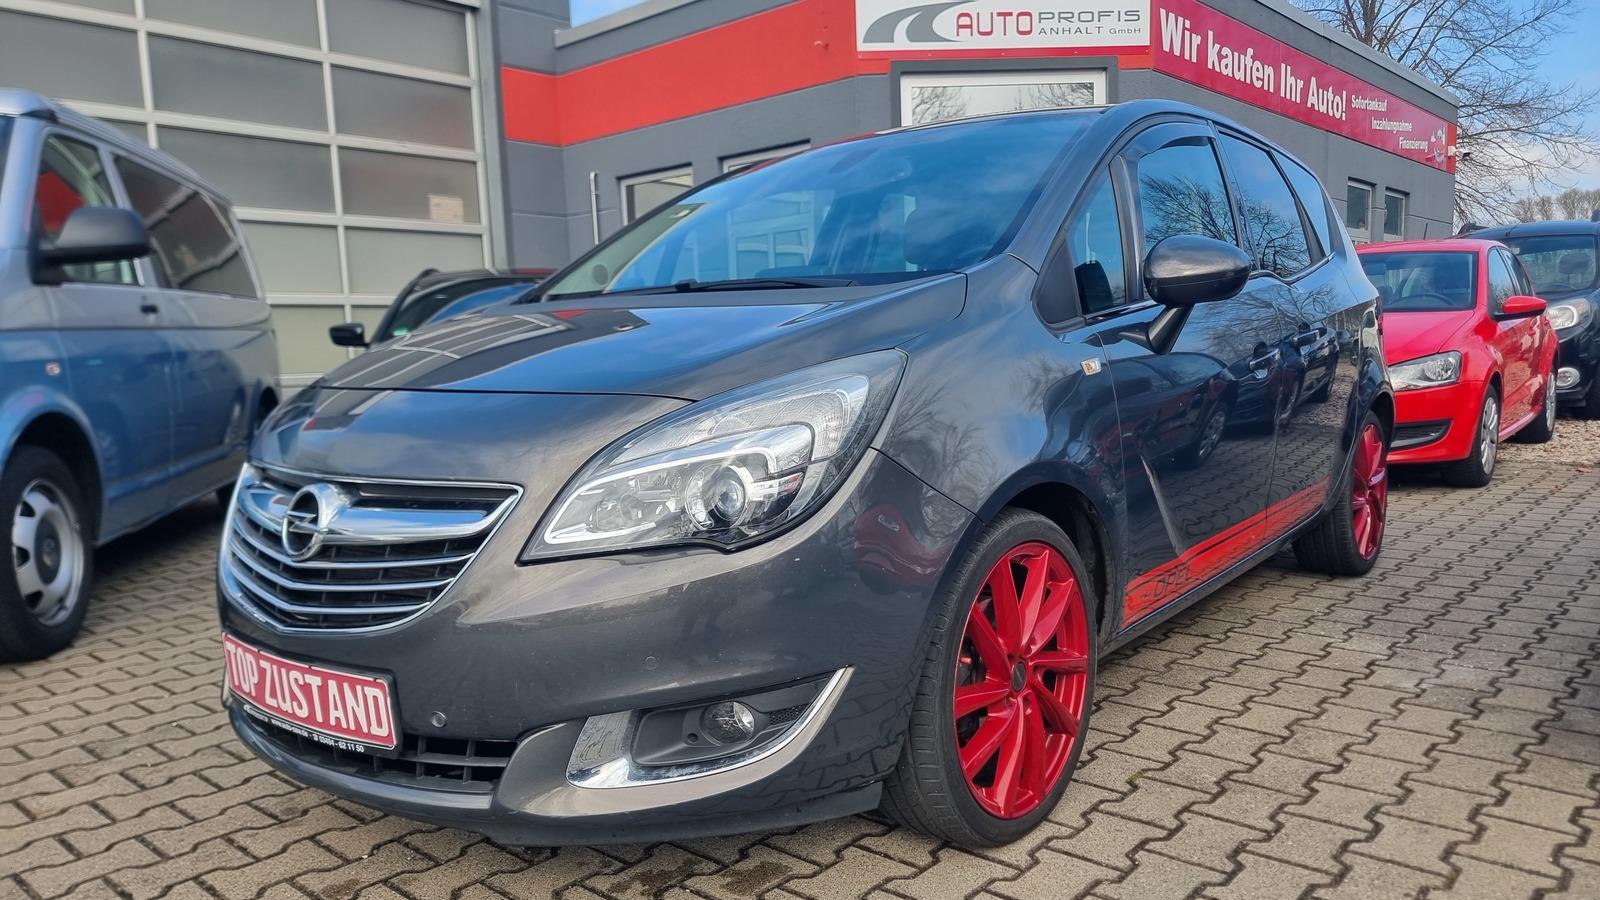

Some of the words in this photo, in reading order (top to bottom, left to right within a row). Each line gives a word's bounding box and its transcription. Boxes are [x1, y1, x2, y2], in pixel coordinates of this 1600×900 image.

[956, 11, 1033, 37] AUTO
[1038, 10, 1141, 23] PROFIS
[1038, 26, 1103, 35] ANHALT
[1109, 27, 1141, 35] GmbH
[1159, 7, 1201, 64] Wir
[1207, 29, 1274, 93] kaufen
[1280, 62, 1303, 104] Ihr
[1307, 76, 1347, 121] Auto!
[1351, 94, 1388, 112] Sofortankauf
[1399, 137, 1428, 152] Finanzierung
[225, 641, 259, 697] TOP
[259, 660, 390, 738] ZUSTAND
[347, 743, 355, 751] 11
